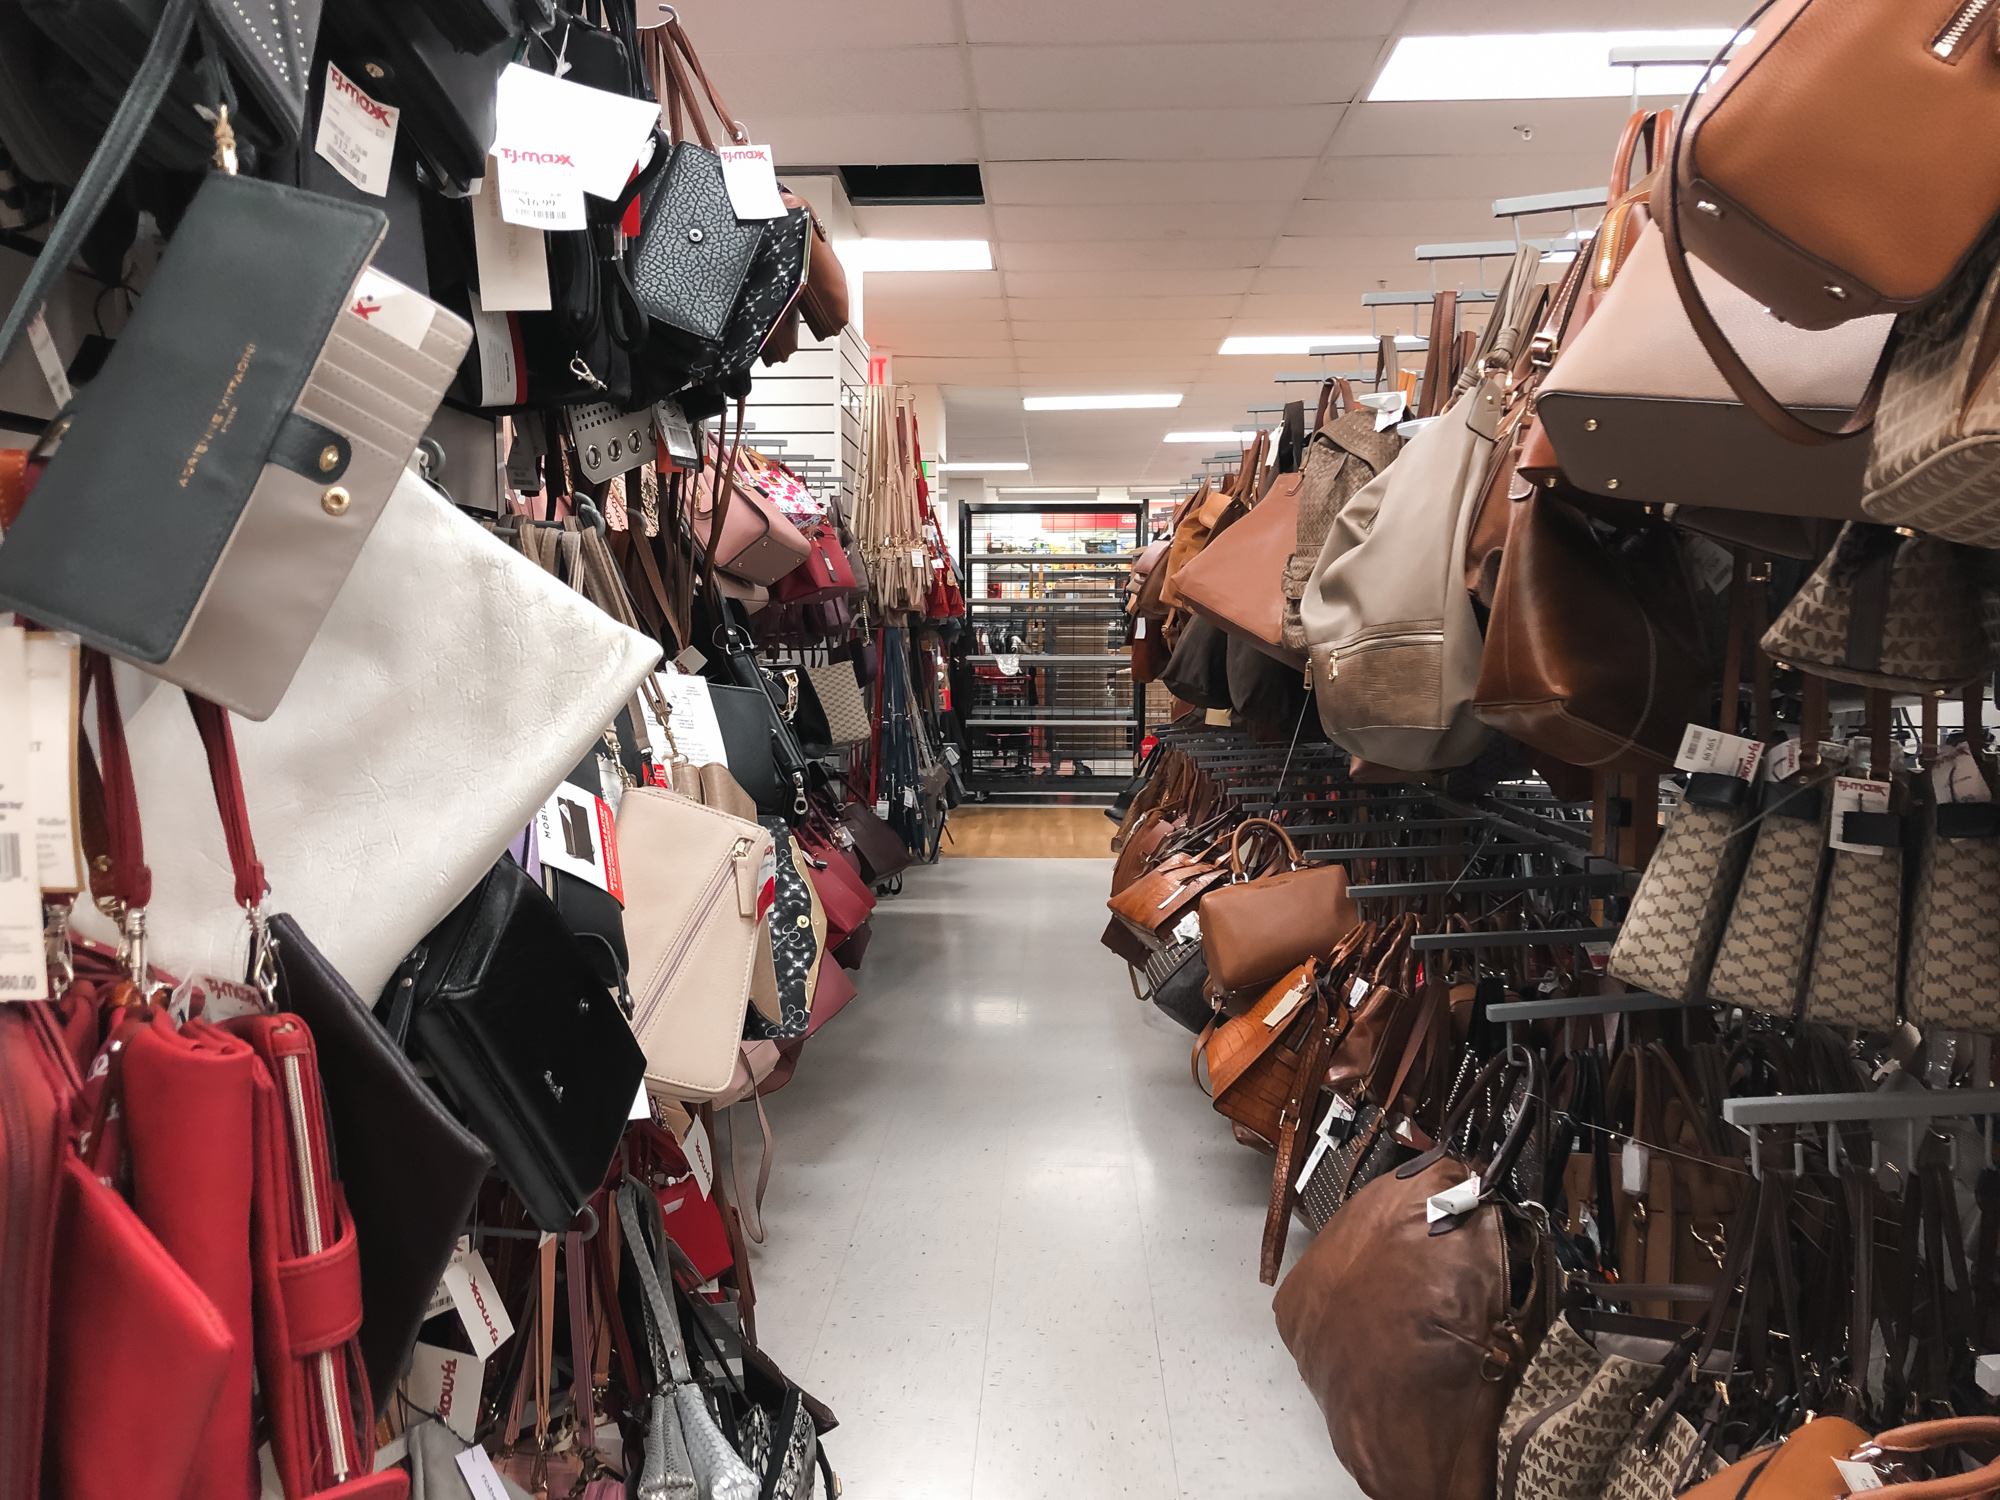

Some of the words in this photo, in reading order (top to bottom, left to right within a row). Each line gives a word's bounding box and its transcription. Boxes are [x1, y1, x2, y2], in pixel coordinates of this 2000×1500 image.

[1800, 602, 1835, 631] MK
[1780, 618, 1810, 647] MK
[599, 803, 608, 834] BATTERY
